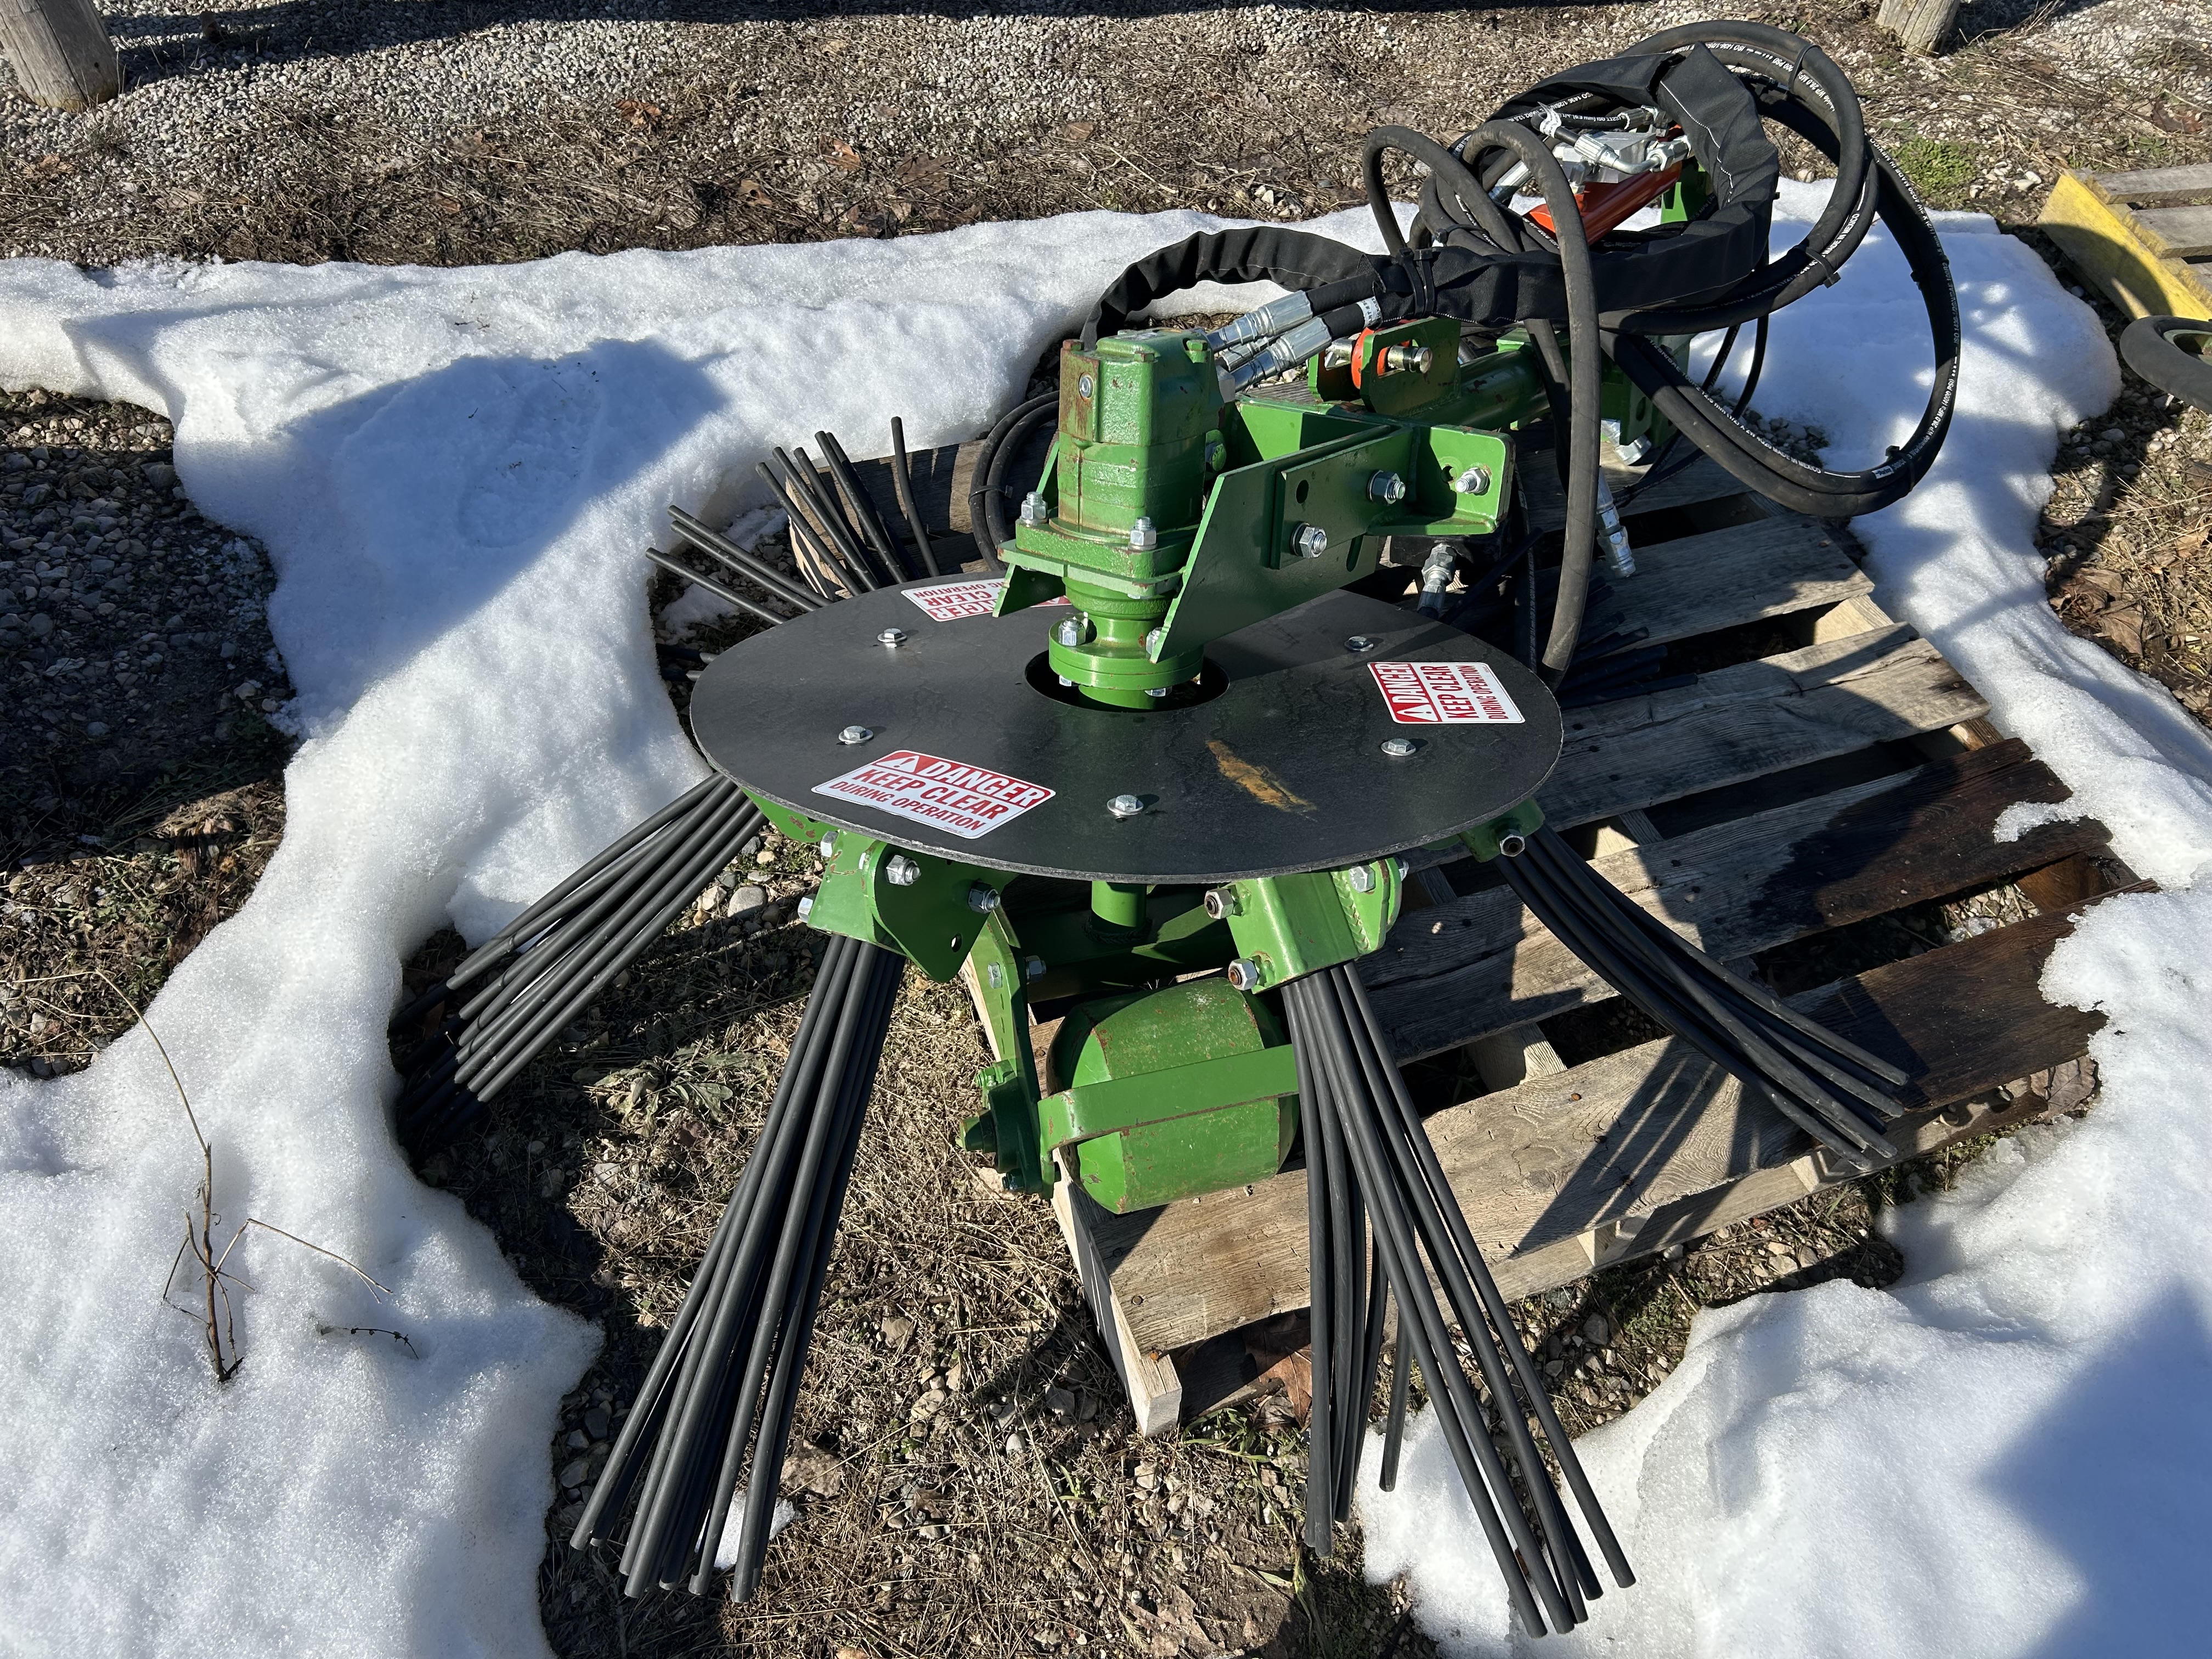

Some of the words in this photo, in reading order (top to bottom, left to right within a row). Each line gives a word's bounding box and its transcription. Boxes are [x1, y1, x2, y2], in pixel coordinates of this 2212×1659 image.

[1869, 138, 1892, 161] MEXICO
[1895, 168, 1910, 187] MADE
[1825, 240, 1842, 255] MADE
[1842, 213, 1860, 234] MEXICO
[1926, 426, 1934, 437] WP
[1773, 446, 1791, 460] MADE
[1791, 456, 1798, 464] IN
[1798, 460, 1822, 474] MEXICO
[913, 584, 986, 598] OPERATION
[923, 591, 992, 606] CLEAR
[935, 599, 998, 618] NGER
[1375, 663, 1430, 704] DANGER
[1420, 666, 1463, 691] CLEAR
[1456, 665, 1493, 694] OPERATION
[1437, 694, 1480, 719] KEEP
[1476, 696, 1509, 719] DURING
[851, 769, 926, 791] KEEP
[921, 787, 1009, 820] CLEAR
[918, 761, 1043, 807] DANGER
[828, 781, 892, 803] DURING
[890, 798, 987, 831] OPERATION
